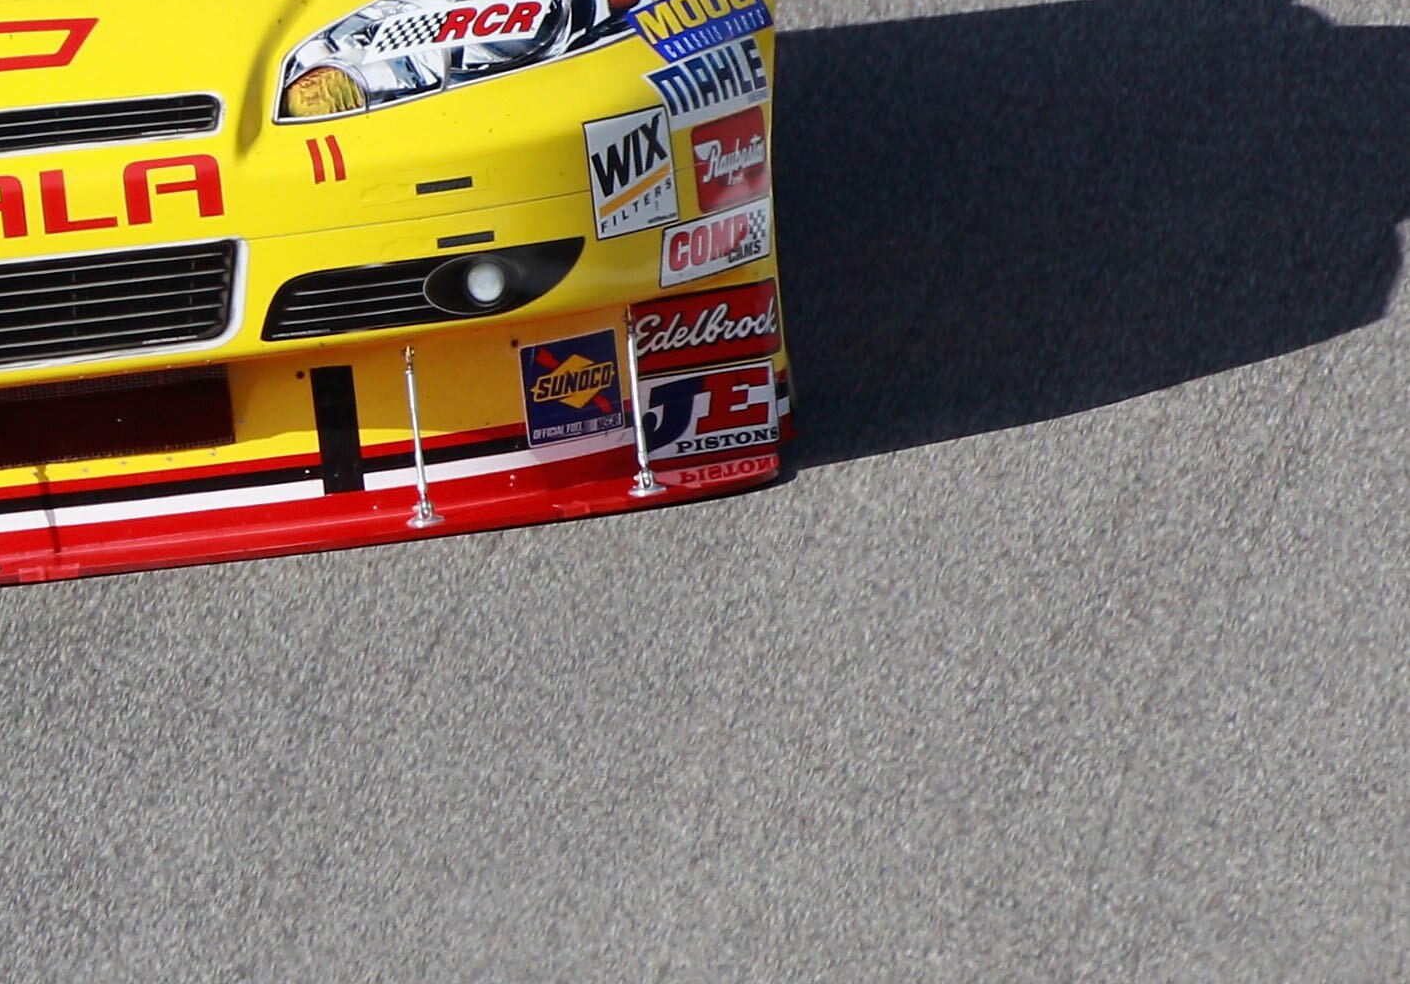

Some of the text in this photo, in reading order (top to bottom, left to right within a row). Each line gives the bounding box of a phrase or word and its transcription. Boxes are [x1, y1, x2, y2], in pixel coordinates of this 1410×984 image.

[432, 2, 543, 43] RCR
[664, 9, 766, 59] CHASSIS PARTS
[648, 37, 768, 117] MAHLE
[591, 112, 668, 198] WIX
[600, 178, 672, 234] FILTERS
[669, 213, 750, 272] COMP
[728, 239, 762, 263] CAMS
[635, 296, 777, 357] Edelbrock
[535, 363, 614, 399] SUNOCO
[643, 366, 770, 453] JE
[676, 427, 778, 454] PISTONS
